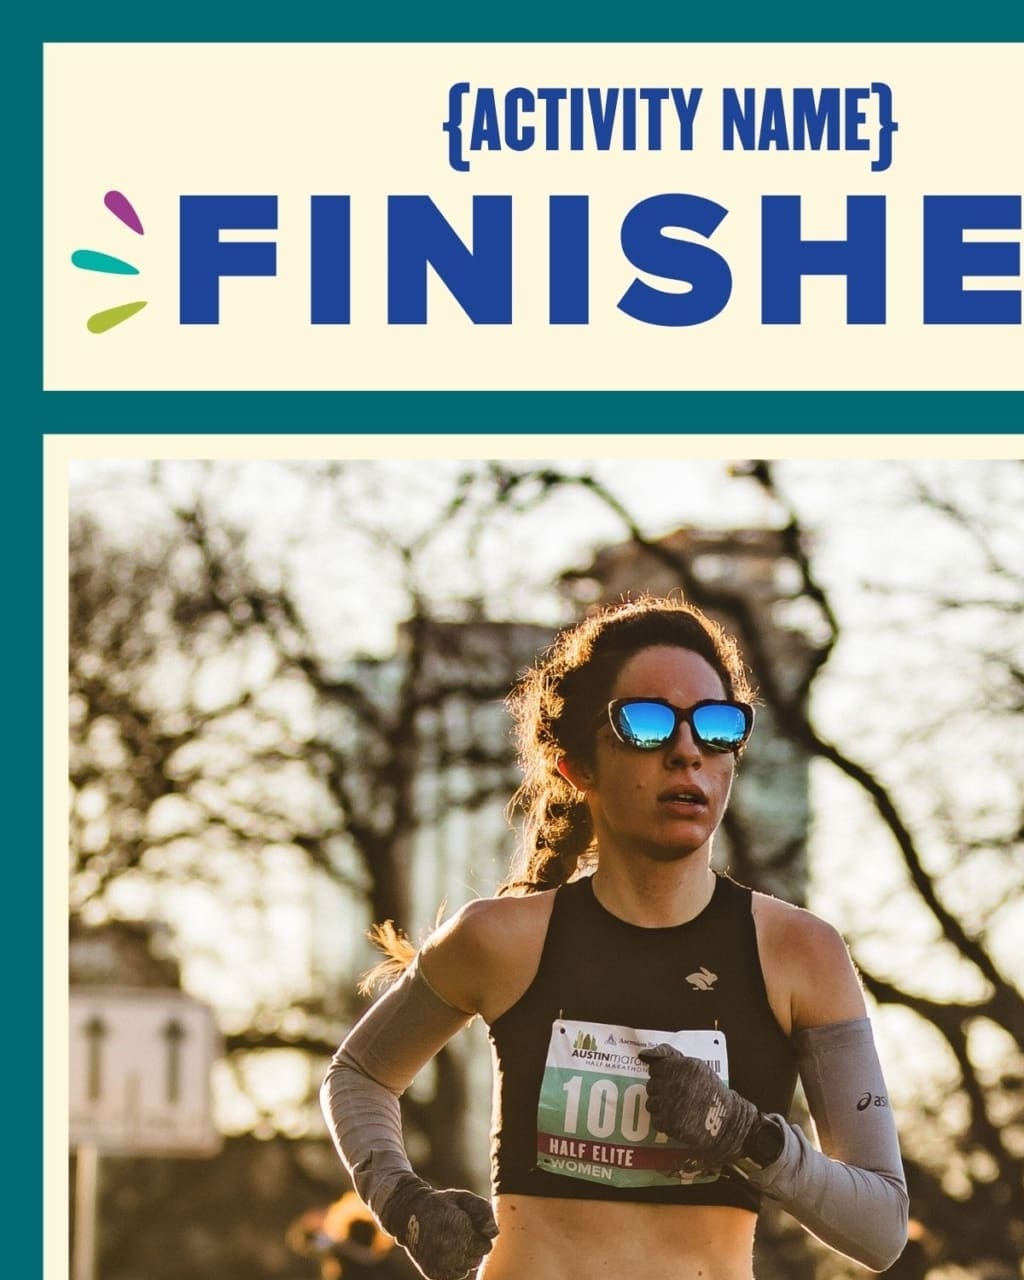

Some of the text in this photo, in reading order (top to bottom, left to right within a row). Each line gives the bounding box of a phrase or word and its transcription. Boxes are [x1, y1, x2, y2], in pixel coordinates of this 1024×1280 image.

[571, 1049, 650, 1067] AUSTINmara
[563, 1075, 669, 1143] 100
[550, 1137, 635, 1167] HALF ELITE
[550, 1158, 613, 1180] WOMEN
